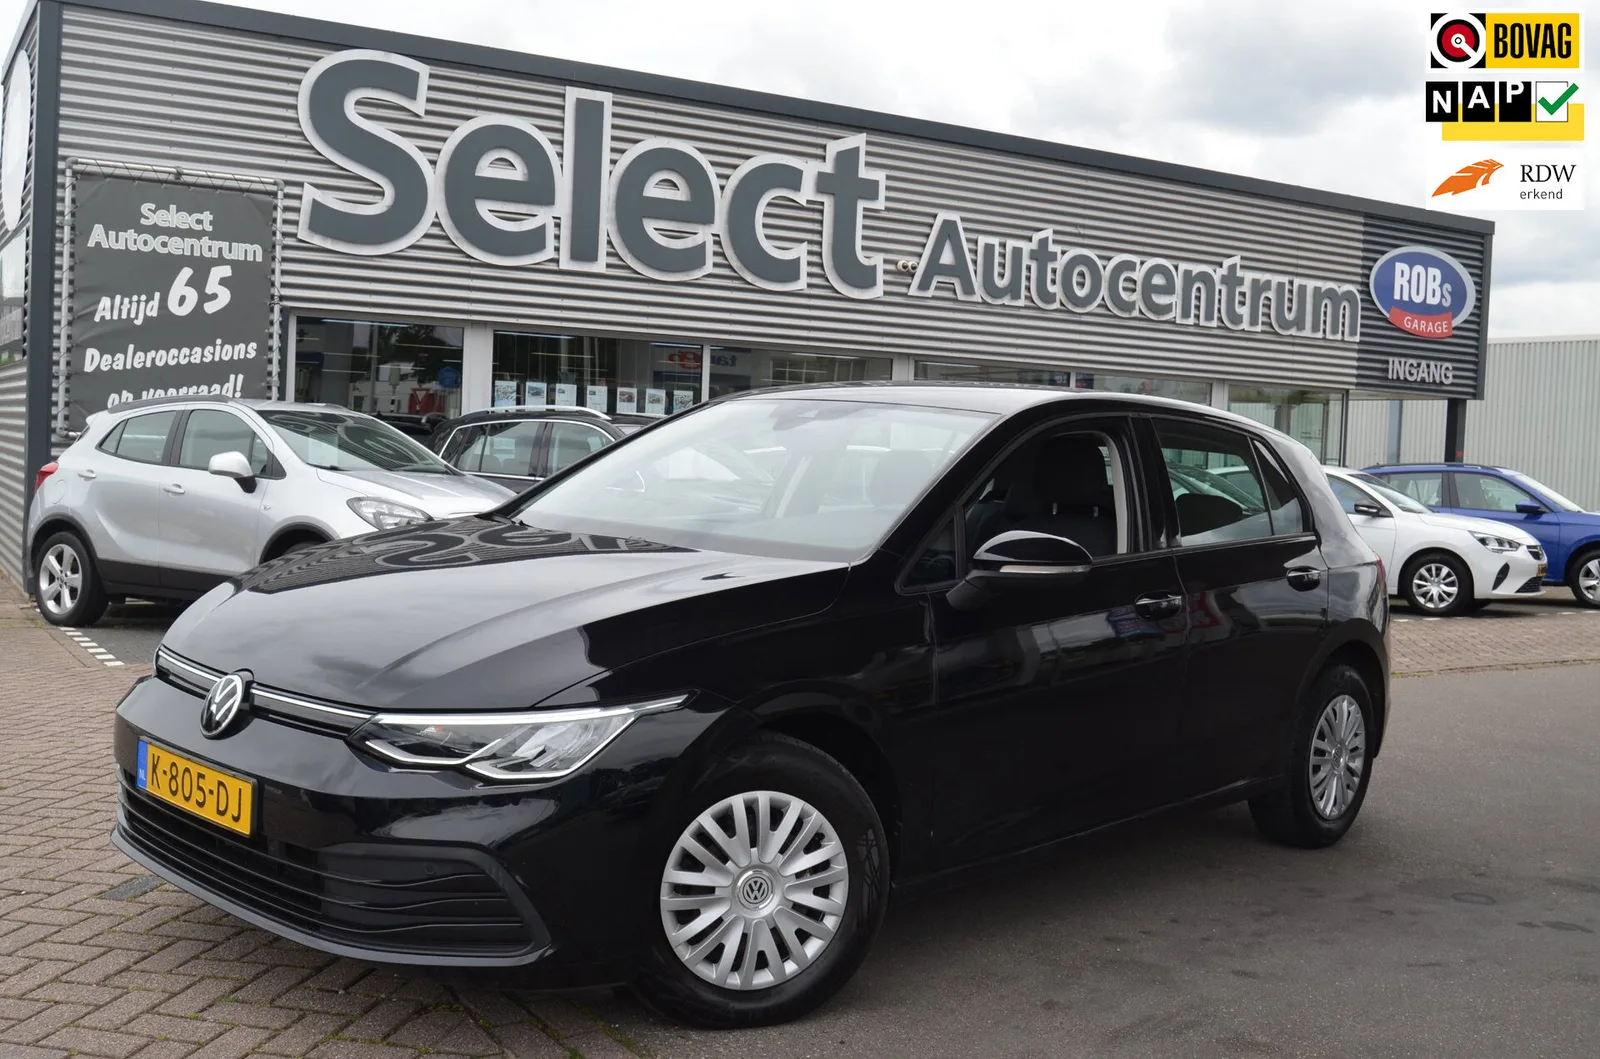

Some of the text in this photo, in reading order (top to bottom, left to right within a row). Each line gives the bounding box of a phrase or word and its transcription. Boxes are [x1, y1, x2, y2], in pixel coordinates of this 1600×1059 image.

[298, 49, 1361, 342] Select Autocentrum
[140, 202, 213, 232] Select
[87, 223, 263, 262] Autocentrum
[93, 265, 233, 326] Altijd 65
[1393, 261, 1452, 308] ROBs
[1404, 315, 1449, 333] GARAGE
[83, 338, 258, 373] Dealeroccasions
[1387, 357, 1453, 385] INGANG
[151, 752, 242, 823] K-805-DJ
